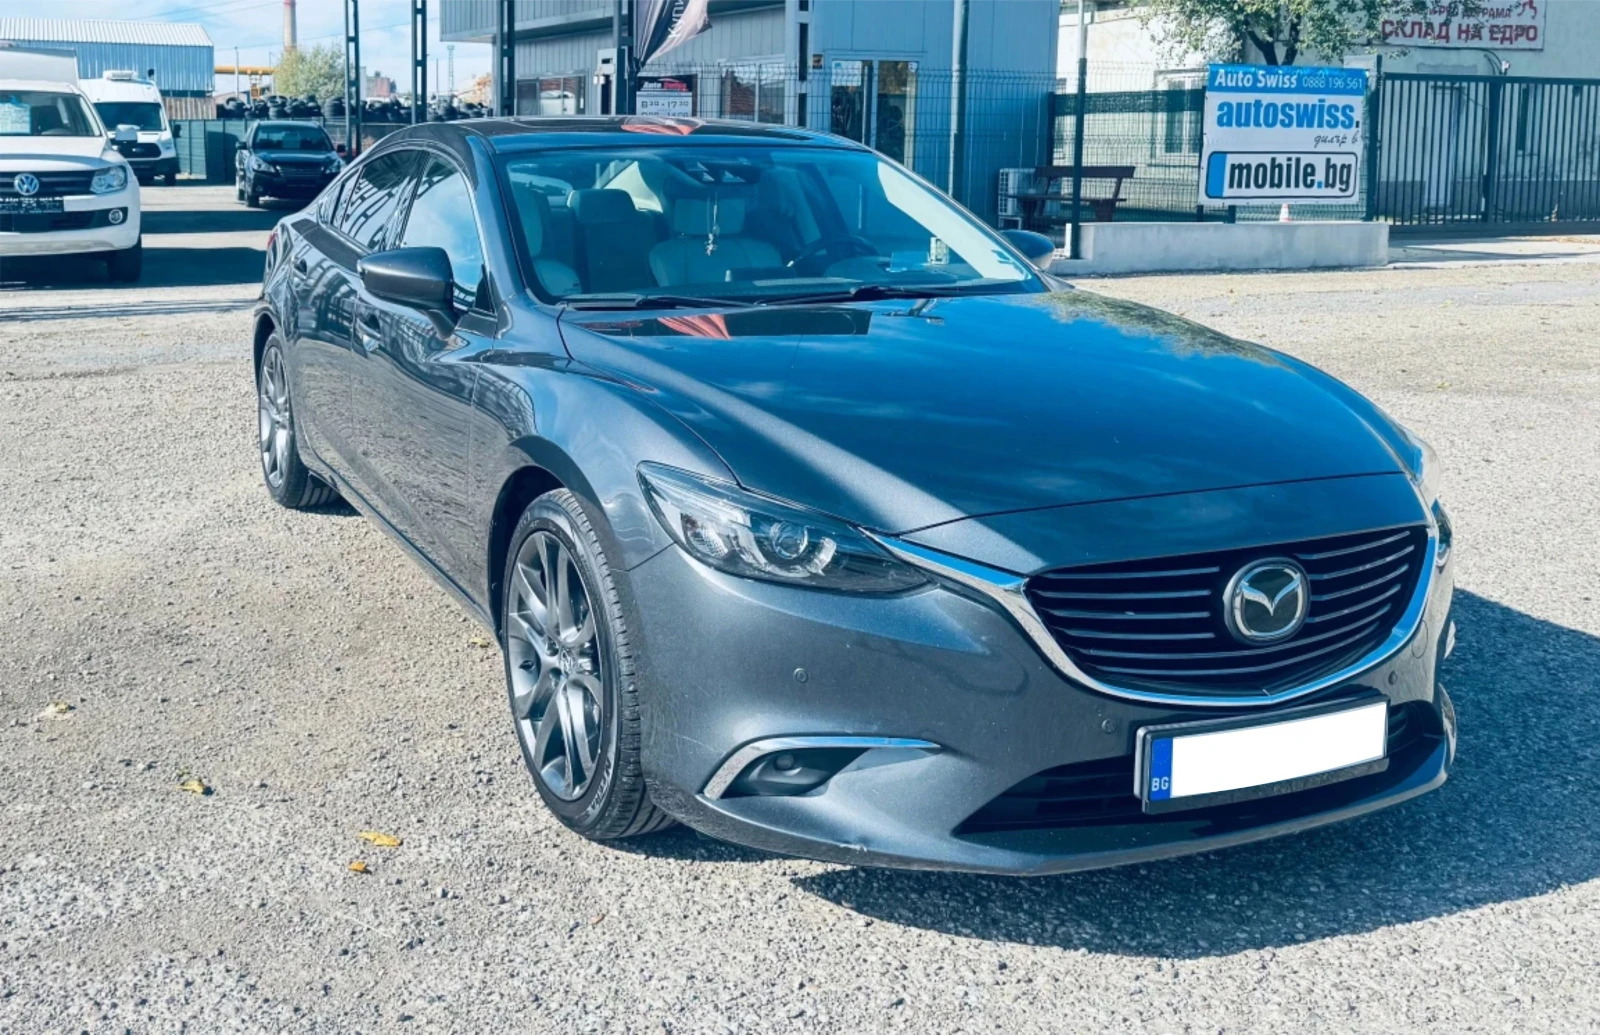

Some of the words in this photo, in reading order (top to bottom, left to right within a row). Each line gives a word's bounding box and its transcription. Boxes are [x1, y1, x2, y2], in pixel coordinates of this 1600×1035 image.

[1381, 19, 1450, 43] СКЛАД
[1457, 23, 1482, 42] НА
[1489, 24, 1538, 44] ЕДРО
[1214, 68, 1253, 87] Auto
[1256, 70, 1298, 88] Swiss
[1303, 76, 1326, 88] 0888
[1329, 77, 1345, 89] 196
[1346, 77, 1363, 89] 561
[1216, 98, 1360, 129] autoswiss.
[1228, 156, 1352, 193] mobile.bg
[1151, 776, 1170, 792] BG
